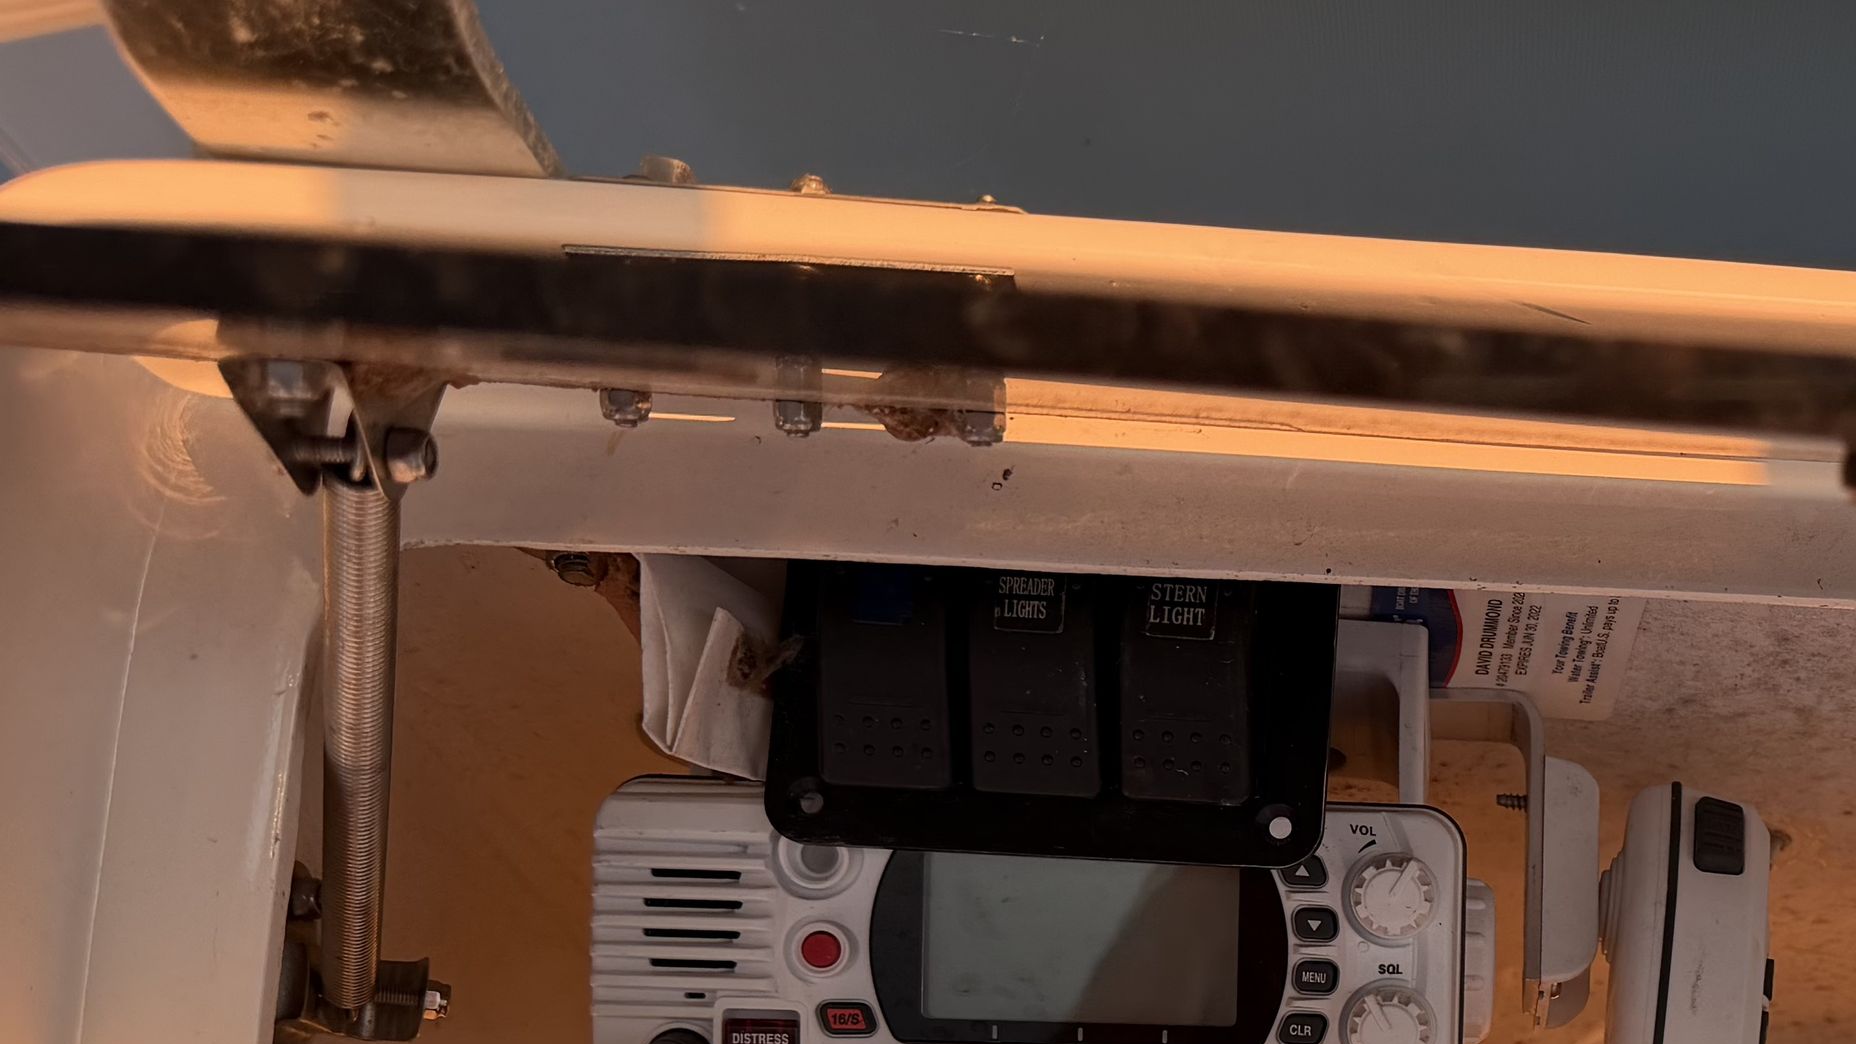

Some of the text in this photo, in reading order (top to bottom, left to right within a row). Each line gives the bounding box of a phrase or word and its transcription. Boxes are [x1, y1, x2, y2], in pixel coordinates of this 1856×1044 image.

[999, 576, 1055, 597] SPREADER
[1151, 583, 1207, 604] STERN
[1003, 601, 1047, 620] LIGHTS
[1607, 605, 1619, 614] up
[1608, 598, 1620, 606] to
[1149, 604, 1205, 626] LIGHT
[1507, 606, 1522, 623] Since
[1527, 605, 1542, 621] 2022
[1602, 615, 1617, 631] pays
[1475, 599, 1502, 675] DAVID DRUMMOND
[1502, 624, 1518, 649] Member
[1521, 632, 1536, 647] JUN
[1551, 611, 1579, 673] Your Towing Benefit
[1568, 664, 1582, 682] Water
[1580, 605, 1599, 634] Unlimited
[1515, 647, 1532, 675] EXPIRES
[1579, 684, 1595, 704] Trailer
[1349, 823, 1377, 838] VOL
[1301, 969, 1327, 985] MENU
[1377, 962, 1403, 976] SQL
[830, 1011, 861, 1026] 16/S
[1289, 1023, 1312, 1038] CLR
